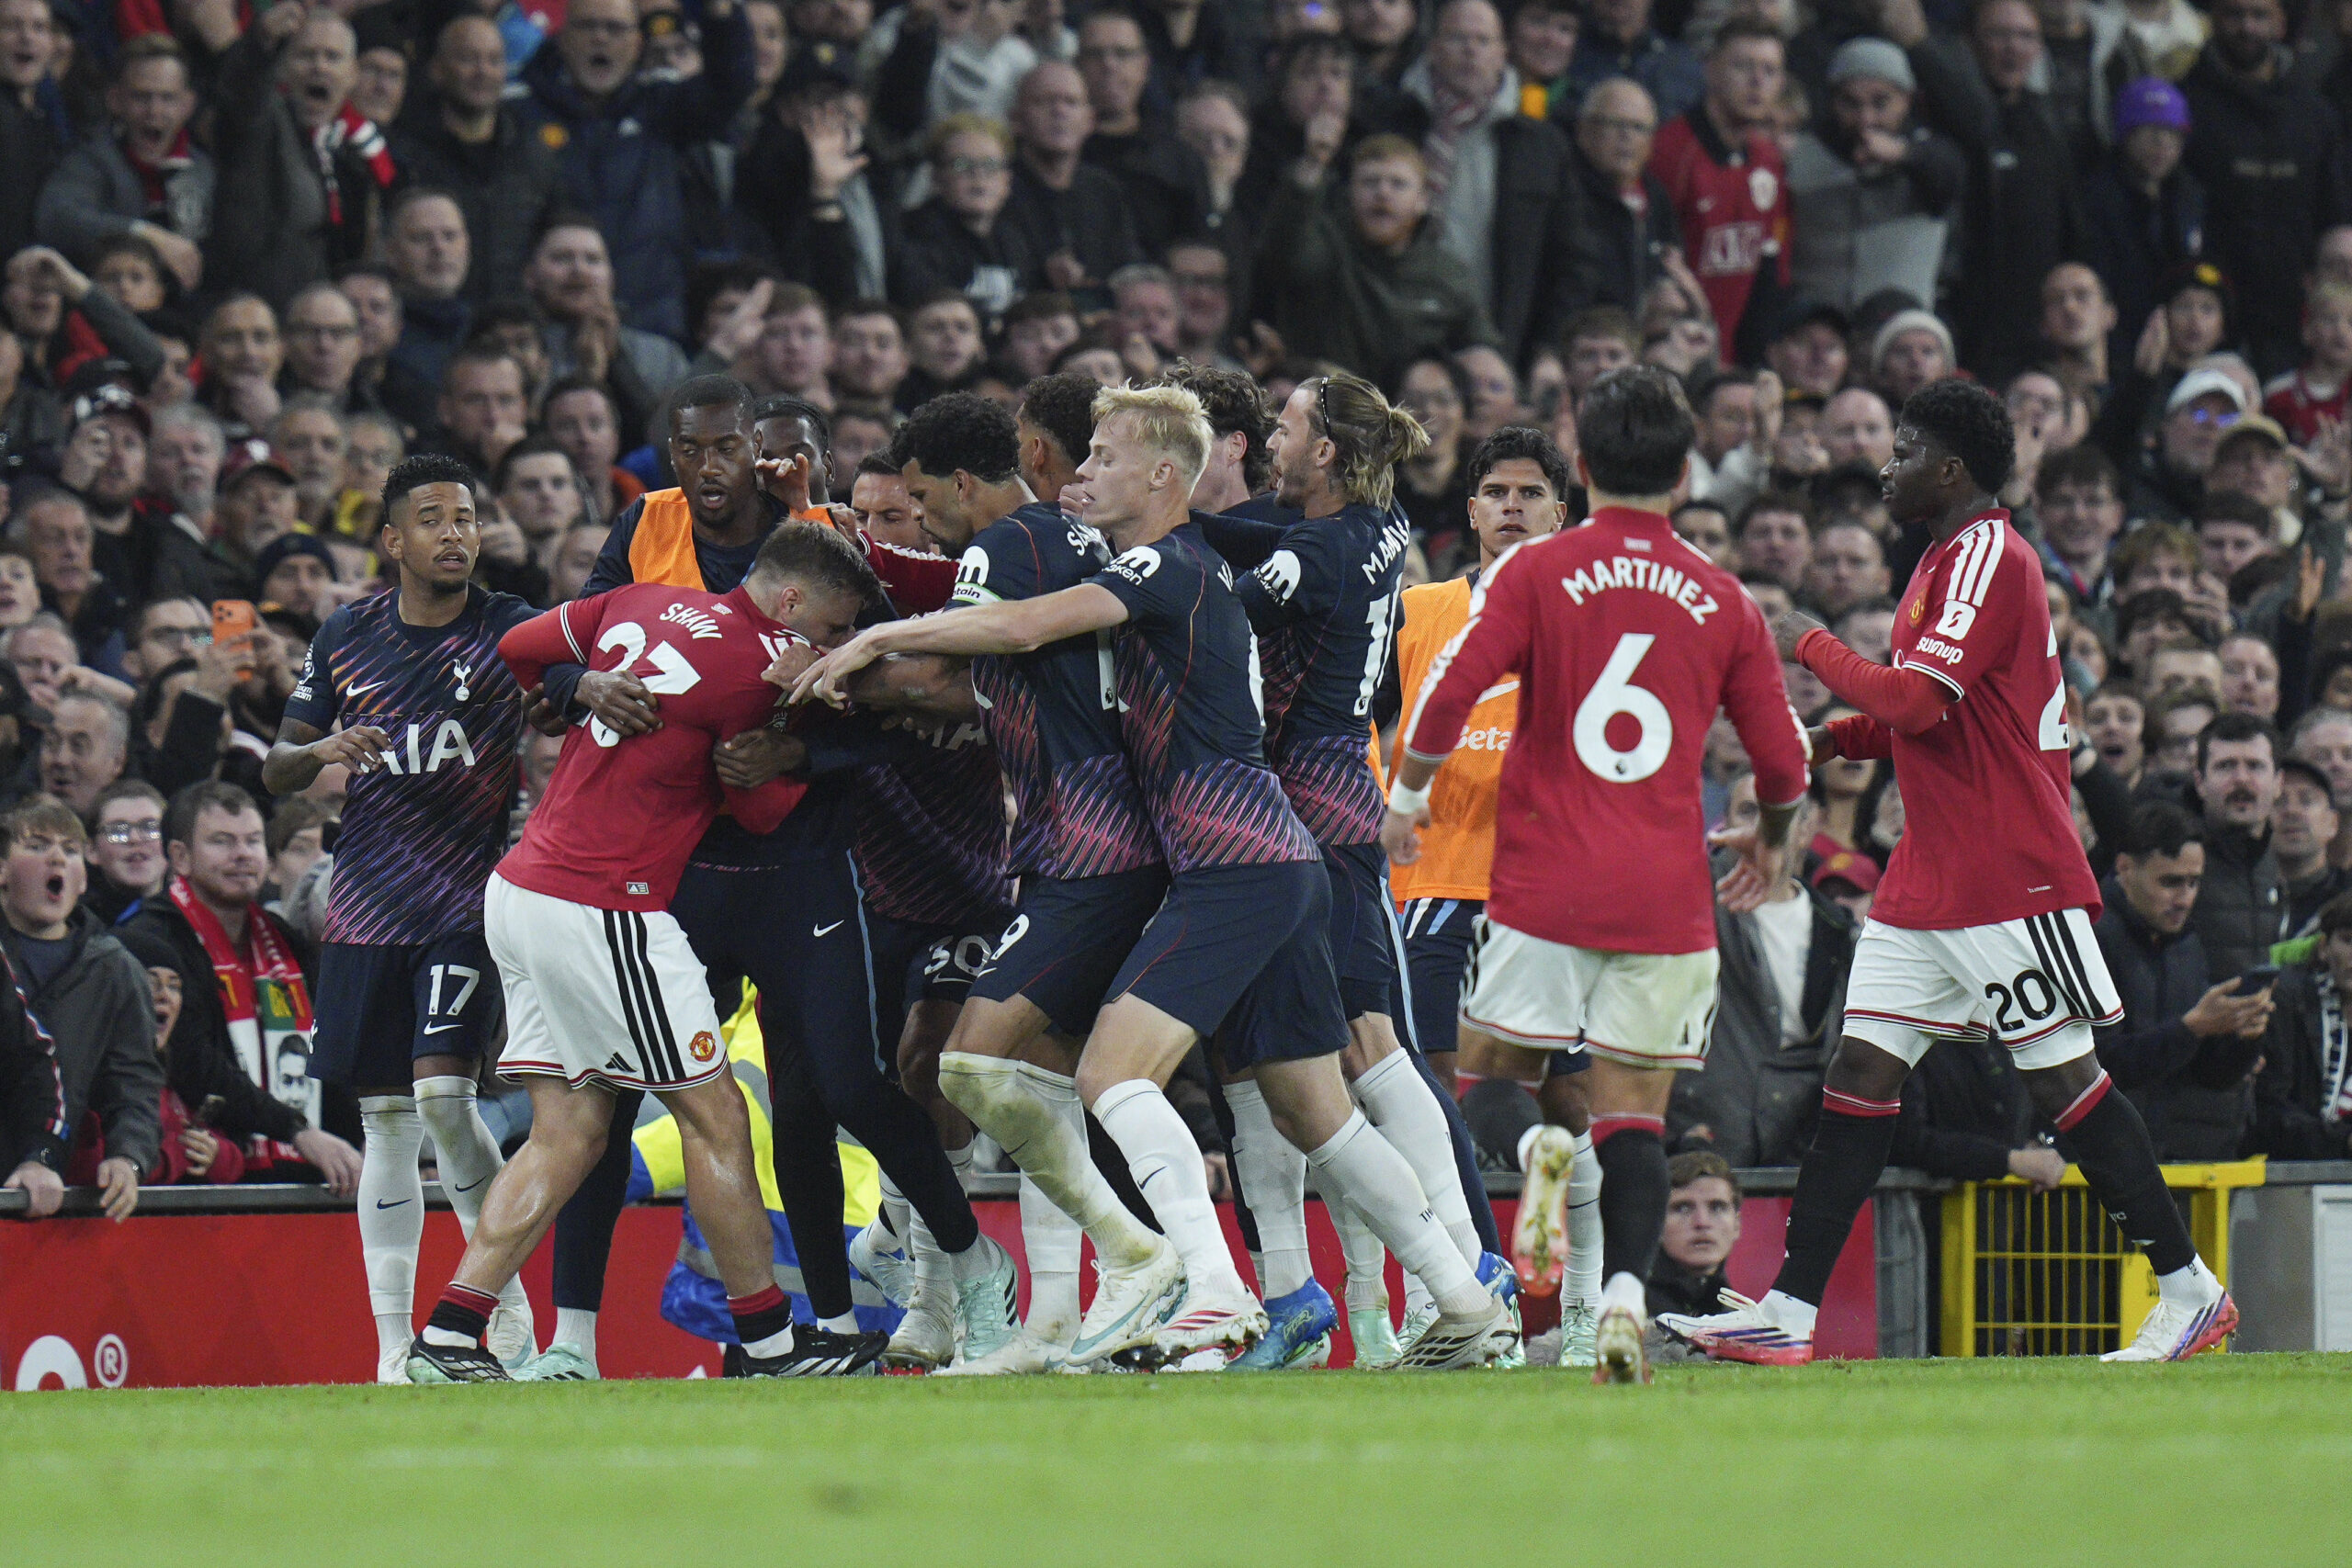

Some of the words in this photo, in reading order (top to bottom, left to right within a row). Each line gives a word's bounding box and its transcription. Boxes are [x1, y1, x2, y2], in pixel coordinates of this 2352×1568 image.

[660, 603, 723, 639] SHAW
[1562, 556, 1719, 626] MARTINEZ
[1573, 632, 1673, 784] 6
[428, 964, 481, 1017] 17
[1984, 969, 2057, 1032] 20
